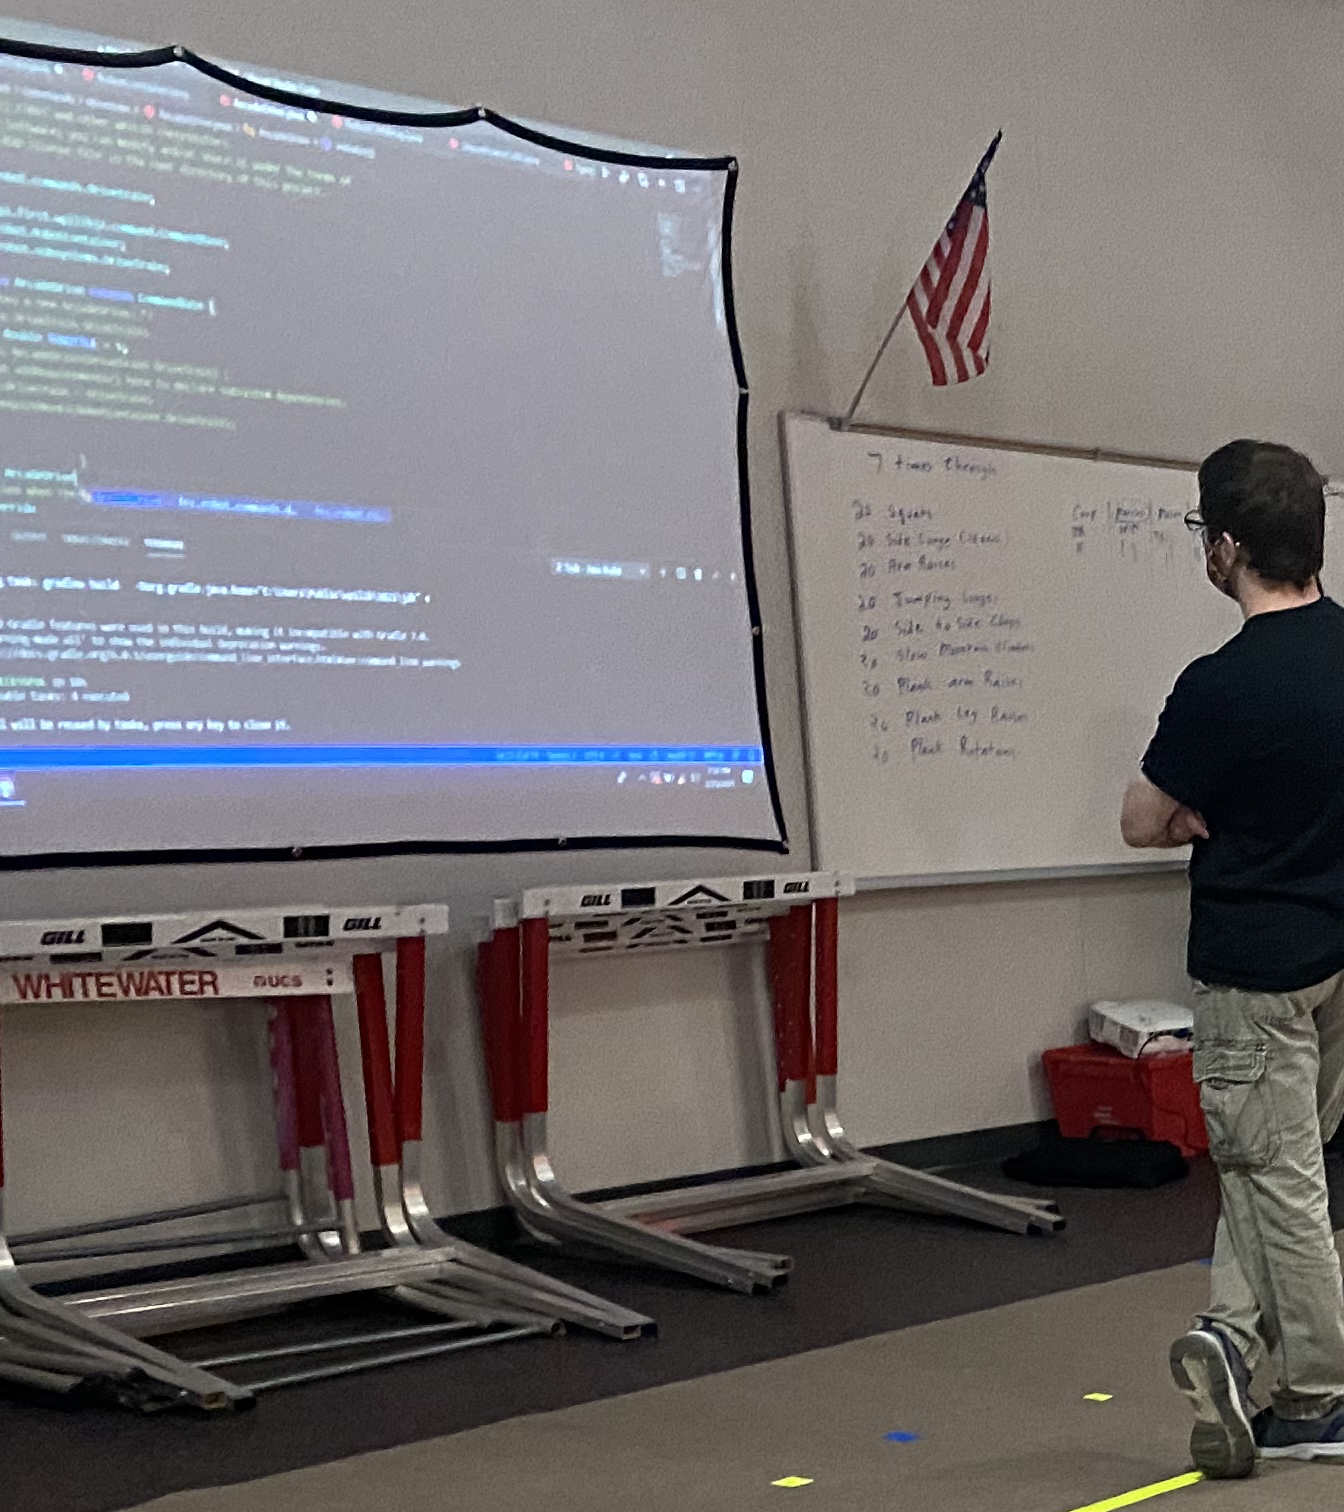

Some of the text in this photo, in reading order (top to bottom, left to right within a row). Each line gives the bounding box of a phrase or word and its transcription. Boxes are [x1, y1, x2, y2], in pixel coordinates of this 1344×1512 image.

[867, 452, 883, 474] 7
[580, 881, 810, 907] GILL GILL
[40, 916, 382, 945] GILL GILL
[12, 970, 219, 1000] WHITEWATER
